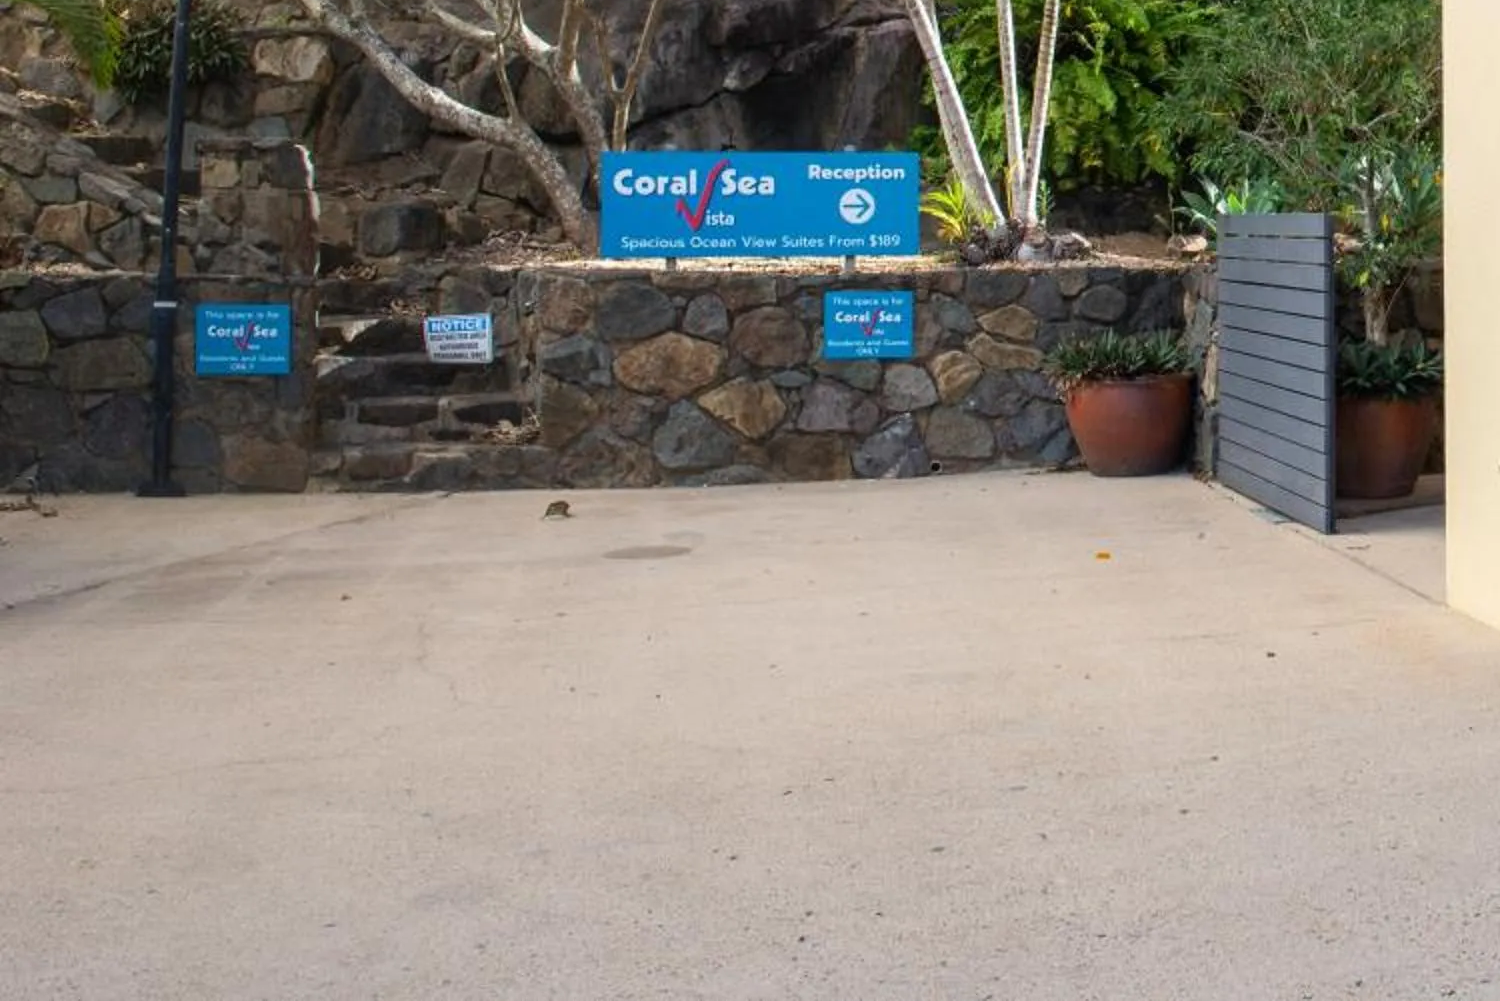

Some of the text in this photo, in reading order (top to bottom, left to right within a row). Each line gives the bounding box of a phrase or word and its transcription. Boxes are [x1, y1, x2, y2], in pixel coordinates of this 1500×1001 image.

[807, 163, 906, 183] Reception
[612, 167, 776, 197] Coral Sea
[620, 233, 901, 251] Spacious Ocean View Suites From $189
[834, 310, 902, 324] Coral Sea
[207, 324, 279, 338] Coral Sea
[430, 319, 484, 333] NOTICE
